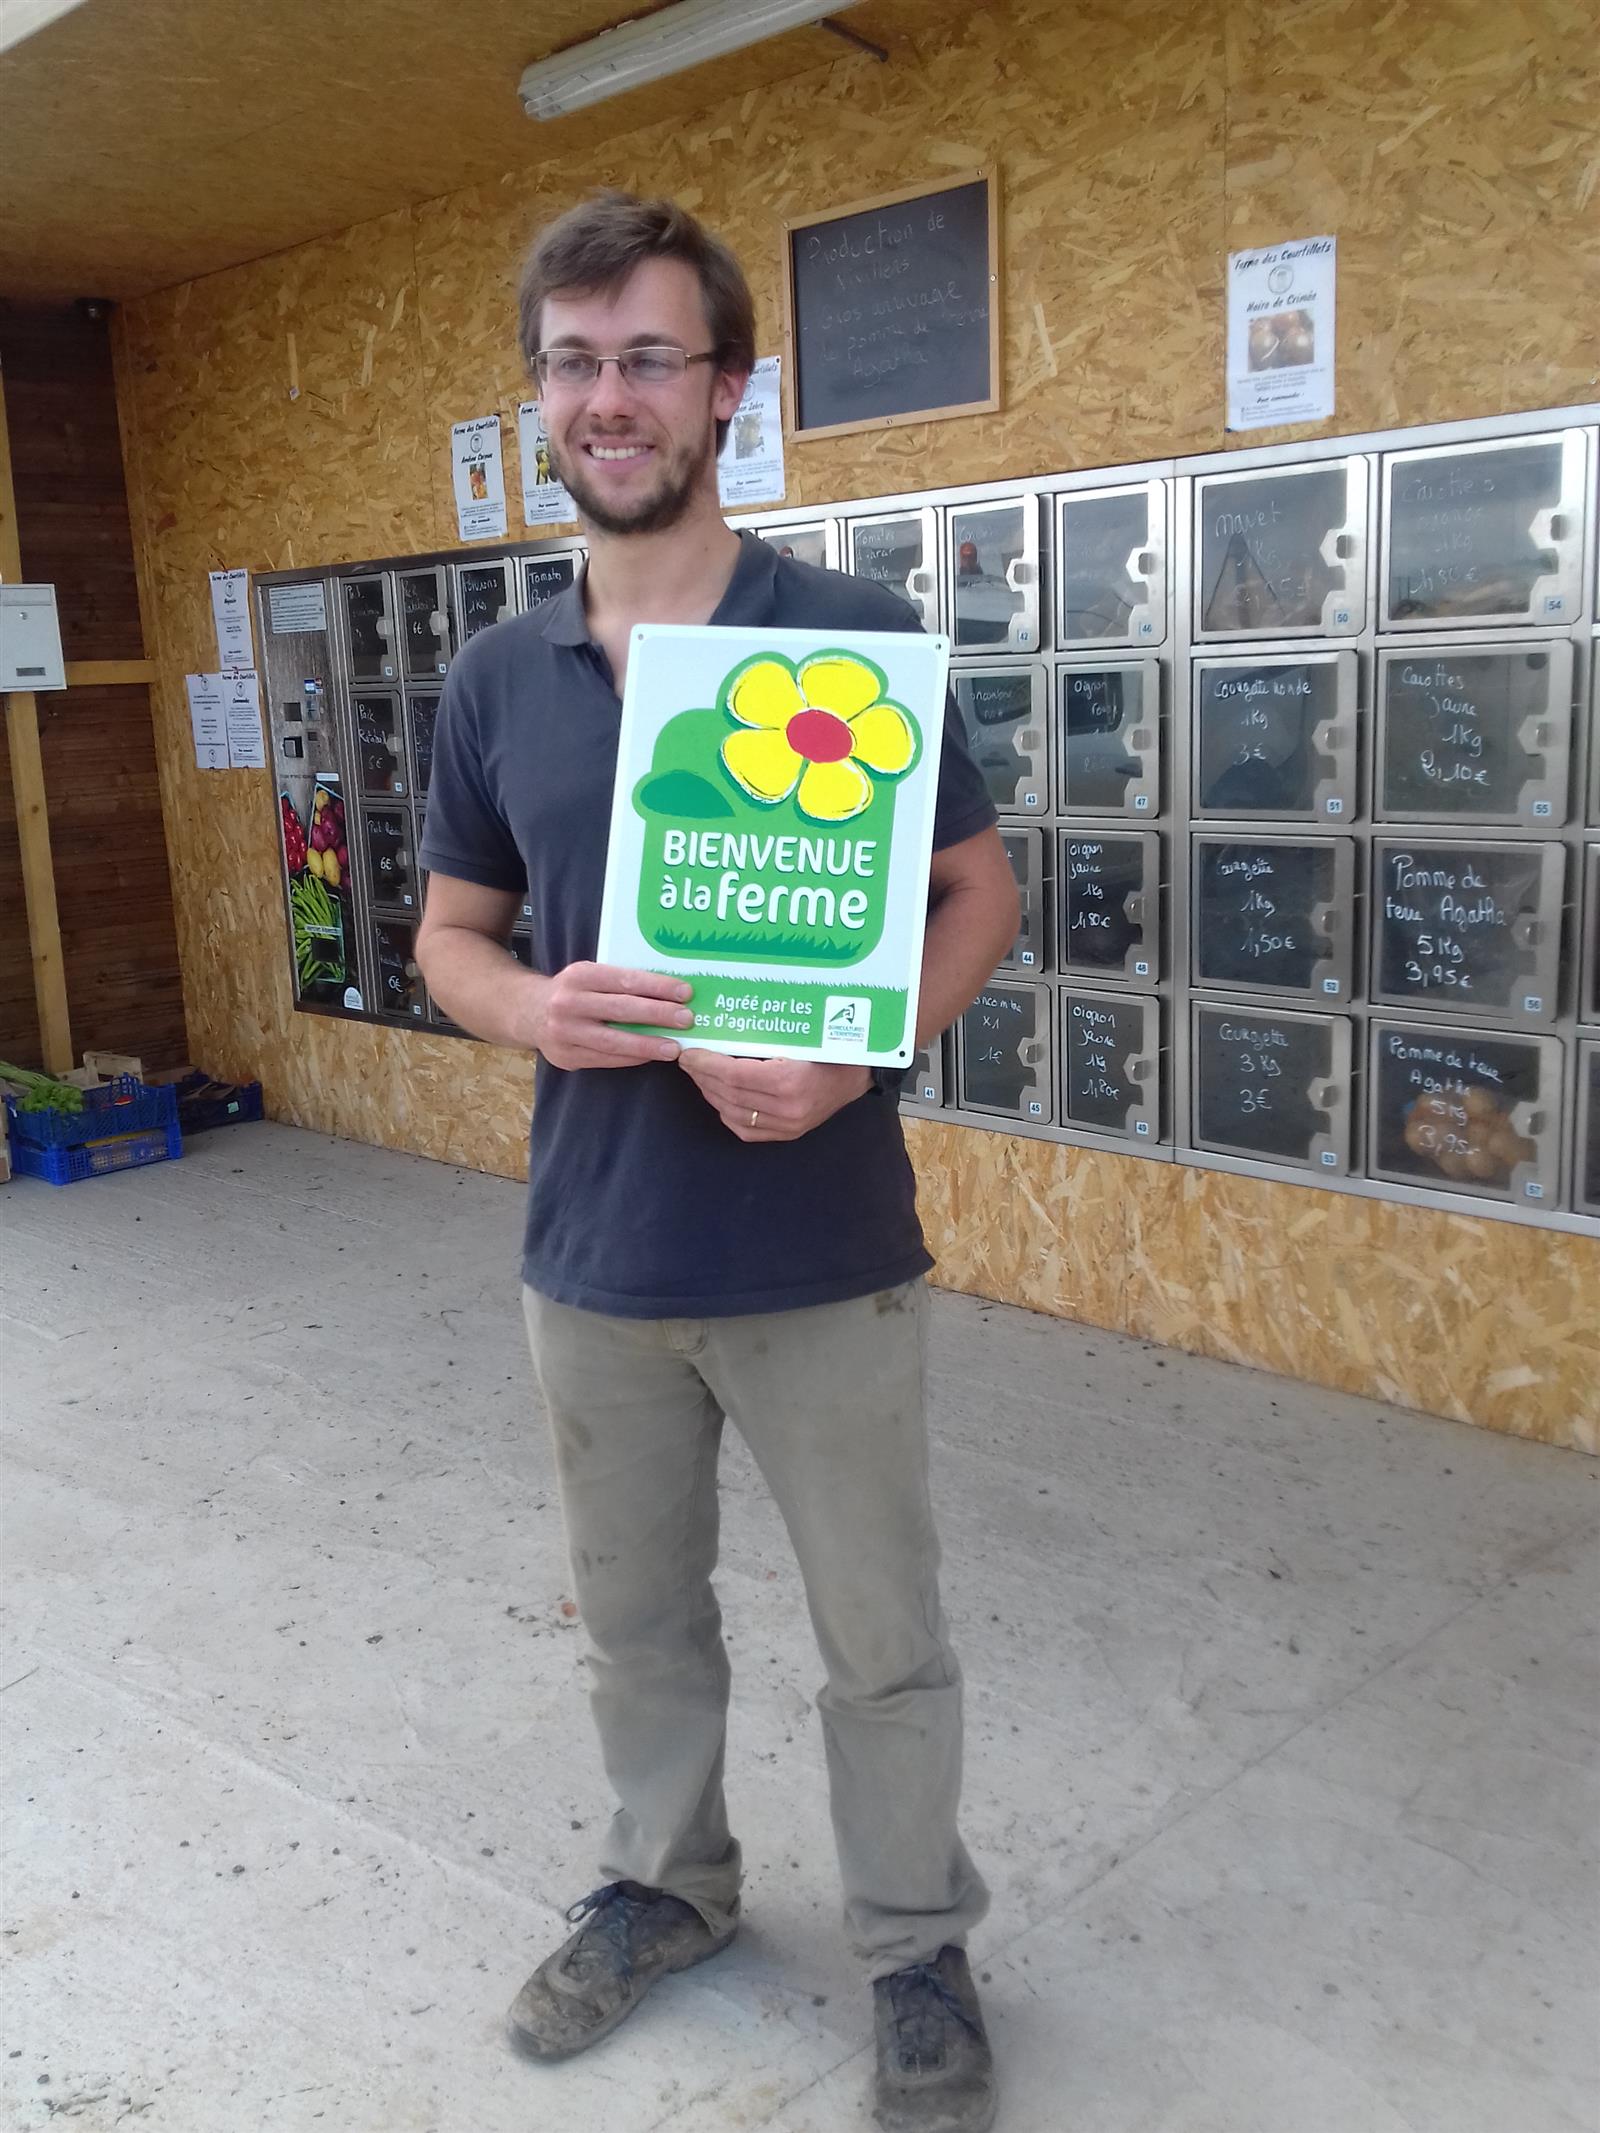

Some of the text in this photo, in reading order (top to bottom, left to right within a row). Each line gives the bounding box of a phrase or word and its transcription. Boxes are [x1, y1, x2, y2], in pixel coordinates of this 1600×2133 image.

[1262, 253, 1278, 264] des
[1548, 599, 1561, 610] 54
[1337, 612, 1348, 624] 50
[1019, 630, 1029, 640] 42
[1027, 795, 1036, 805] 43
[1136, 797, 1146, 807] 47
[1329, 800, 1340, 811] 51
[1535, 803, 1549, 814] 55
[663, 829, 877, 878] BIENVENUE
[1392, 854, 1487, 891] Pomme de
[659, 870, 868, 930] à la ferme
[1240, 927, 1297, 957] 1,50€
[1023, 954, 1033, 963] 44
[1137, 963, 1146, 973] 48
[1405, 961, 1473, 988] 3,95€
[1325, 981, 1337, 991] 52
[715, 993, 813, 1015] Agréé par les
[973, 996, 1024, 1014] oncombre
[714, 1013, 811, 1034] d'agriculture
[1389, 1036, 1442, 1063] Pomme
[1444, 1050, 1463, 1069] de
[925, 1087, 934, 1098] 41
[1240, 1088, 1272, 1113] 3€
[1031, 1103, 1040, 1113] 45
[1138, 1122, 1147, 1133] 49
[1323, 1154, 1335, 1165] 53
[1527, 1184, 1540, 1195] 57
